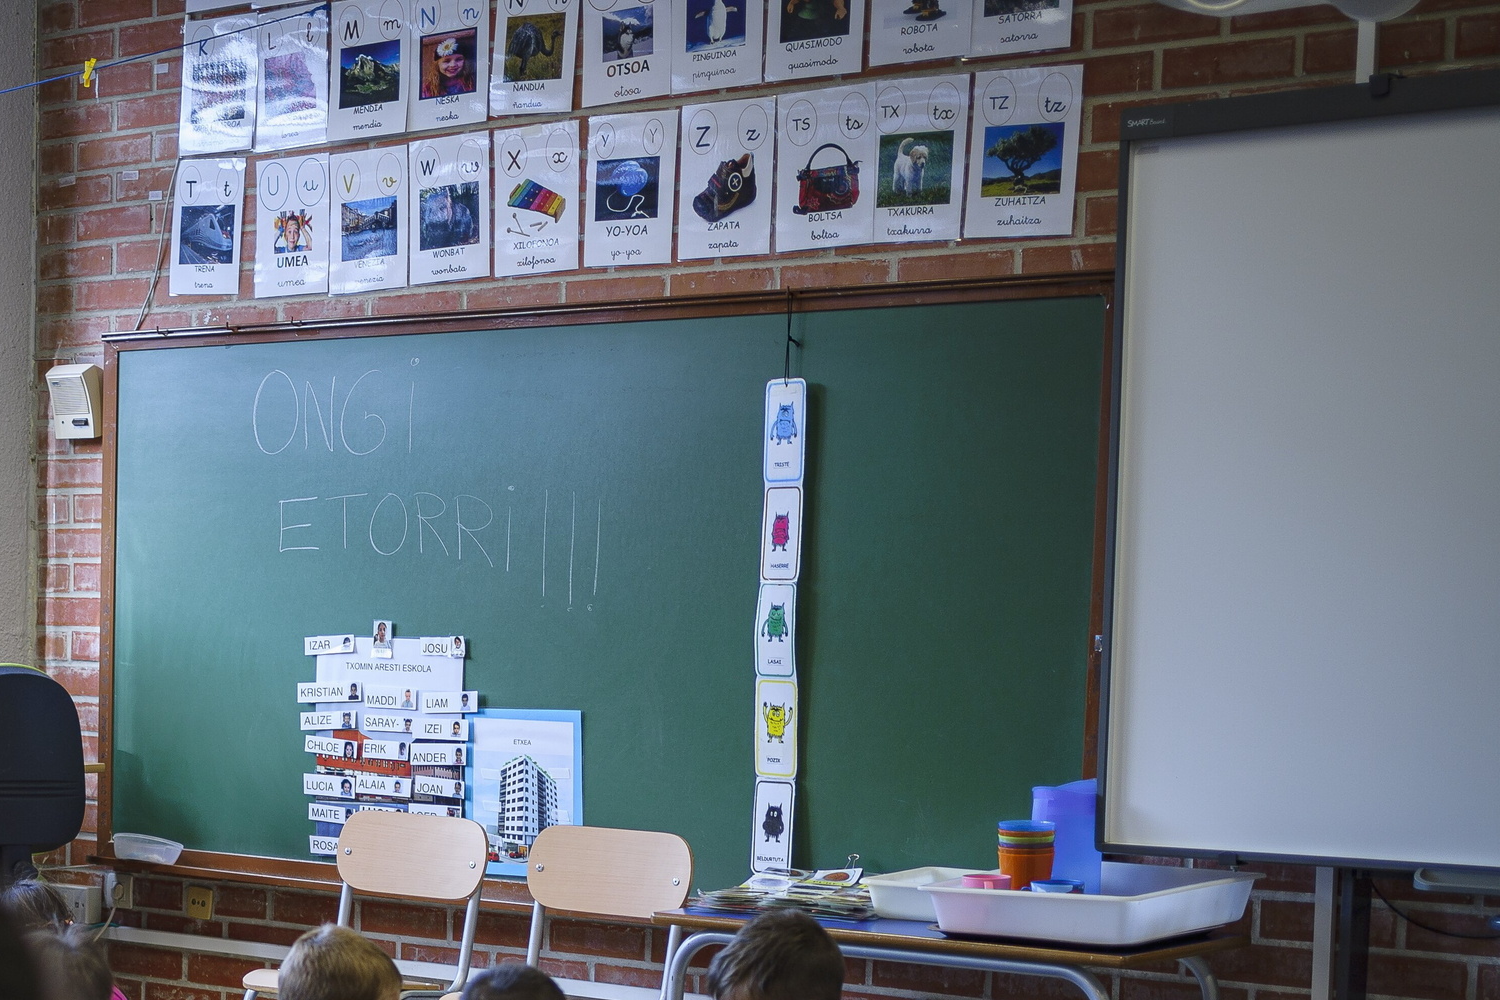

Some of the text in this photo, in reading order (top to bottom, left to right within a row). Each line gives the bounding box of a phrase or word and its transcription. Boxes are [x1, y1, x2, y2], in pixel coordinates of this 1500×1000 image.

[420, 6, 479, 28] N n
[998, 11, 1042, 24] SATORRA
[344, 18, 400, 41] M m
[901, 23, 938, 36] ROBOTA
[267, 32, 277, 50] L
[785, 36, 843, 53] QUASIMODO
[1000, 33, 1038, 44] satorra
[199, 40, 208, 56] K
[903, 43, 935, 55] robota
[692, 50, 737, 62] PINGUINOA
[607, 59, 650, 78] OTSOA
[788, 56, 839, 73] quasimodo
[692, 67, 736, 82] pinguinoa
[513, 82, 545, 92] ÑANDUA
[614, 85, 641, 98] otsoa
[436, 95, 460, 105] NESKA
[513, 101, 542, 109] ñandua
[989, 96, 1068, 113] TZ tz
[353, 104, 383, 115] MENDIA
[881, 104, 955, 120] TX tx
[436, 111, 460, 122] neska
[353, 120, 382, 131] mendia
[792, 116, 864, 131] TS ts
[1127, 118, 1150, 128] SMART
[696, 125, 760, 147] Z z
[507, 149, 568, 171] X x
[420, 158, 480, 176] W w
[186, 180, 232, 198] T t
[267, 175, 318, 196] U u
[343, 173, 398, 194] V v
[994, 195, 1046, 207] ZUHAITZA
[808, 211, 843, 222] BOLTSA
[887, 206, 934, 217] TXAKURRA
[708, 221, 740, 231] ZAPATA
[996, 215, 1042, 226] zuhaitza
[605, 224, 648, 237] YO-YOA
[811, 229, 839, 241] boltsa
[886, 226, 933, 236] txakurra
[513, 238, 559, 250] XILOFONOA
[708, 241, 739, 252] zapata
[432, 247, 465, 259] WONBAT
[610, 248, 642, 260] yo-yoa
[277, 255, 309, 268] UMEA
[354, 258, 385, 268] VENEZIA
[516, 256, 557, 268] xilofonoa
[195, 265, 215, 273] TRENA
[431, 264, 467, 276] wonbata
[277, 278, 306, 287] umea
[309, 640, 331, 650] IZAR
[422, 643, 448, 654] JOSU
[346, 662, 432, 673] TXOMIN ARESTI ESKOLA
[300, 687, 343, 697] KRISTIAN
[366, 695, 397, 706] MADDI
[426, 698, 448, 709] LIAM
[304, 714, 332, 726] ALIZE
[424, 723, 442, 734] IZEI
[307, 740, 339, 754] CHLOE
[364, 743, 387, 754] ERIK
[412, 752, 447, 763] ANDER
[306, 781, 334, 792] LUCIA
[358, 779, 386, 791] ALAIA
[416, 783, 443, 794] JOAN
[311, 808, 340, 819] MAITE
